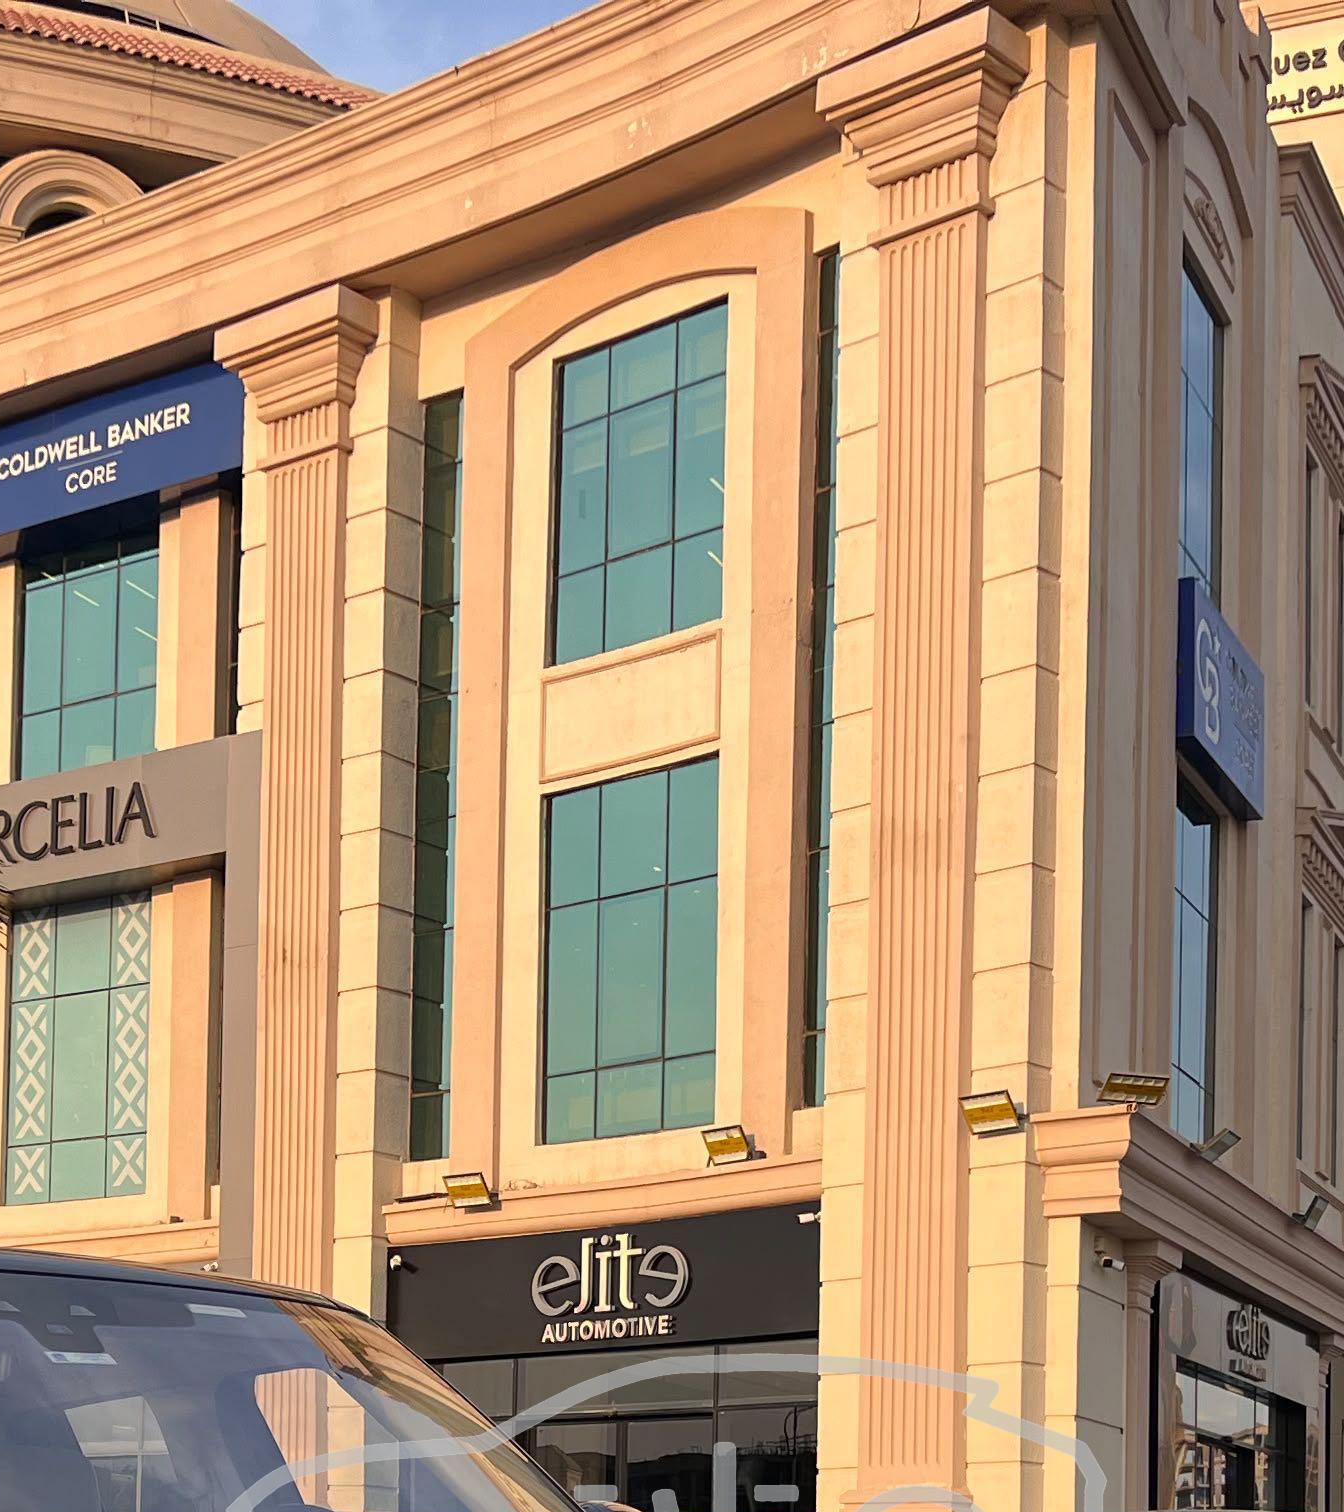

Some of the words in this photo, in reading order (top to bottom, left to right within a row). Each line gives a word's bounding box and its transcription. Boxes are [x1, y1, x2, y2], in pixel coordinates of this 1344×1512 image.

[1271, 47, 1327, 76] uez
[107, 402, 191, 449] BANKER
[65, 461, 118, 493] CORE
[531, 1233, 691, 1317] elite
[541, 1314, 673, 1344] AUTOMOTIVE
